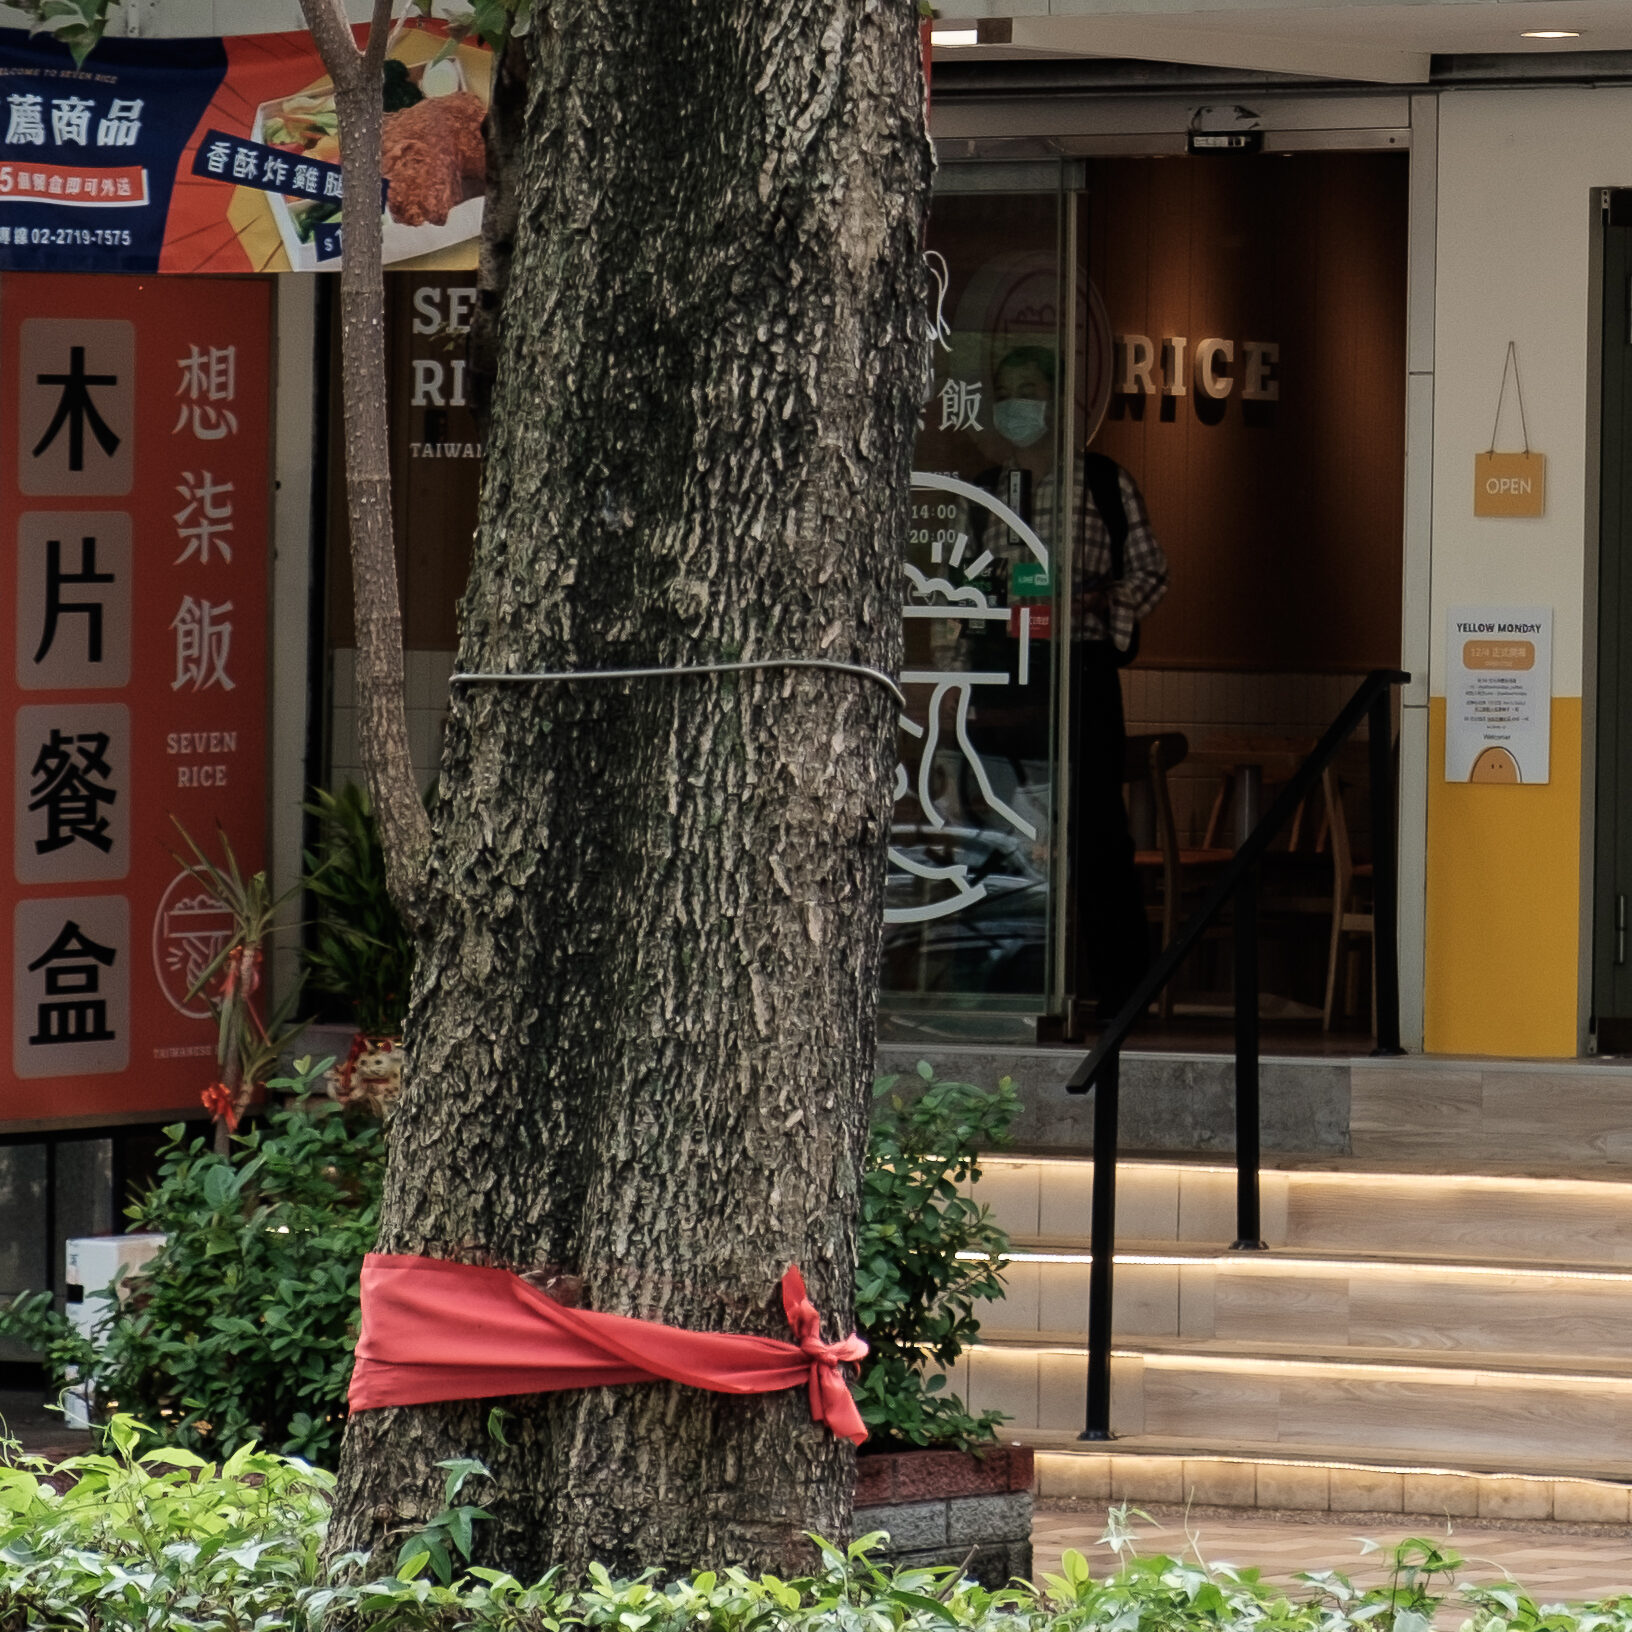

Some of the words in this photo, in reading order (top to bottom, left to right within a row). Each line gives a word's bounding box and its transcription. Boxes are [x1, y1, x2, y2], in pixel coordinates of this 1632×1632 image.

[5, 94, 144, 146] 薦商品
[1118, 333, 1280, 401] RICE
[1486, 476, 1531, 495] OPEN
[168, 342, 239, 693] 想柒飯
[911, 504, 957, 520] 14:00
[1456, 622, 1495, 633] YELLOW
[1498, 623, 1542, 634] MONDAY
[27, 345, 122, 1046] 木片餐盒
[166, 731, 238, 755] SEVEN
[177, 765, 228, 788] RICE
